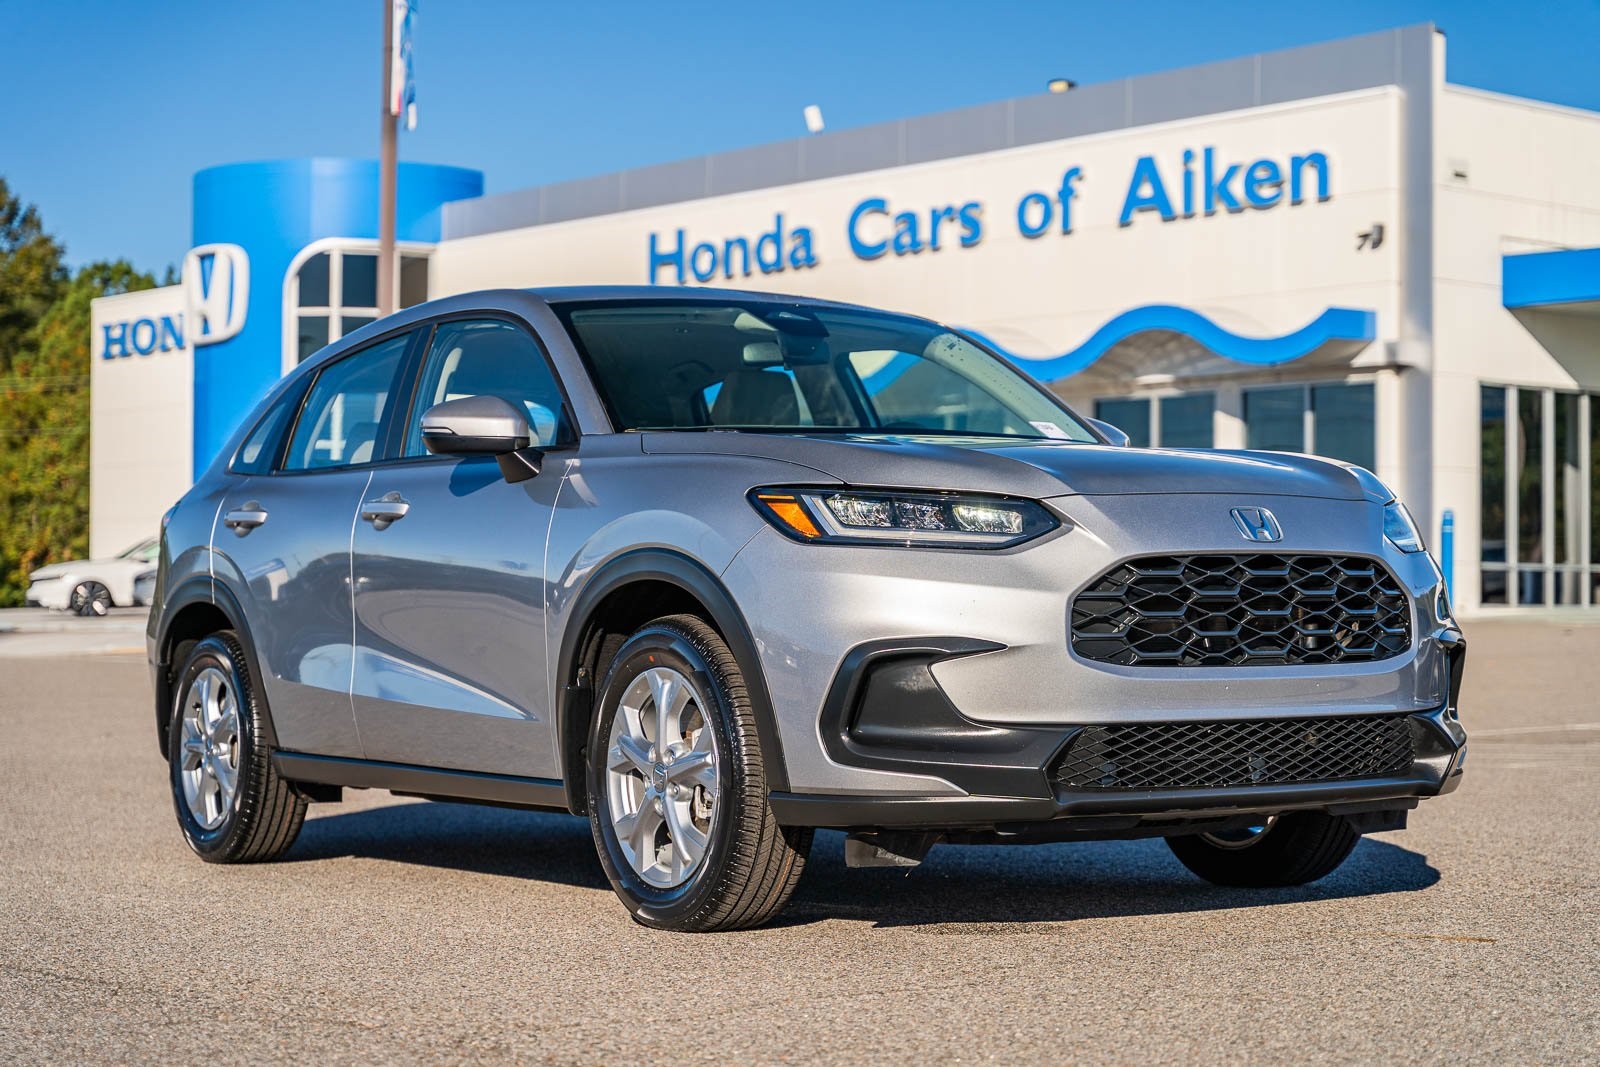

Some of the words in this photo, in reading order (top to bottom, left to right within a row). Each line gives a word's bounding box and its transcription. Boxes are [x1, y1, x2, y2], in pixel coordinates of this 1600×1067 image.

[647, 213, 818, 285] Honda
[847, 197, 984, 260] Cars
[1016, 165, 1083, 238] of
[1119, 146, 1332, 226] Aiken
